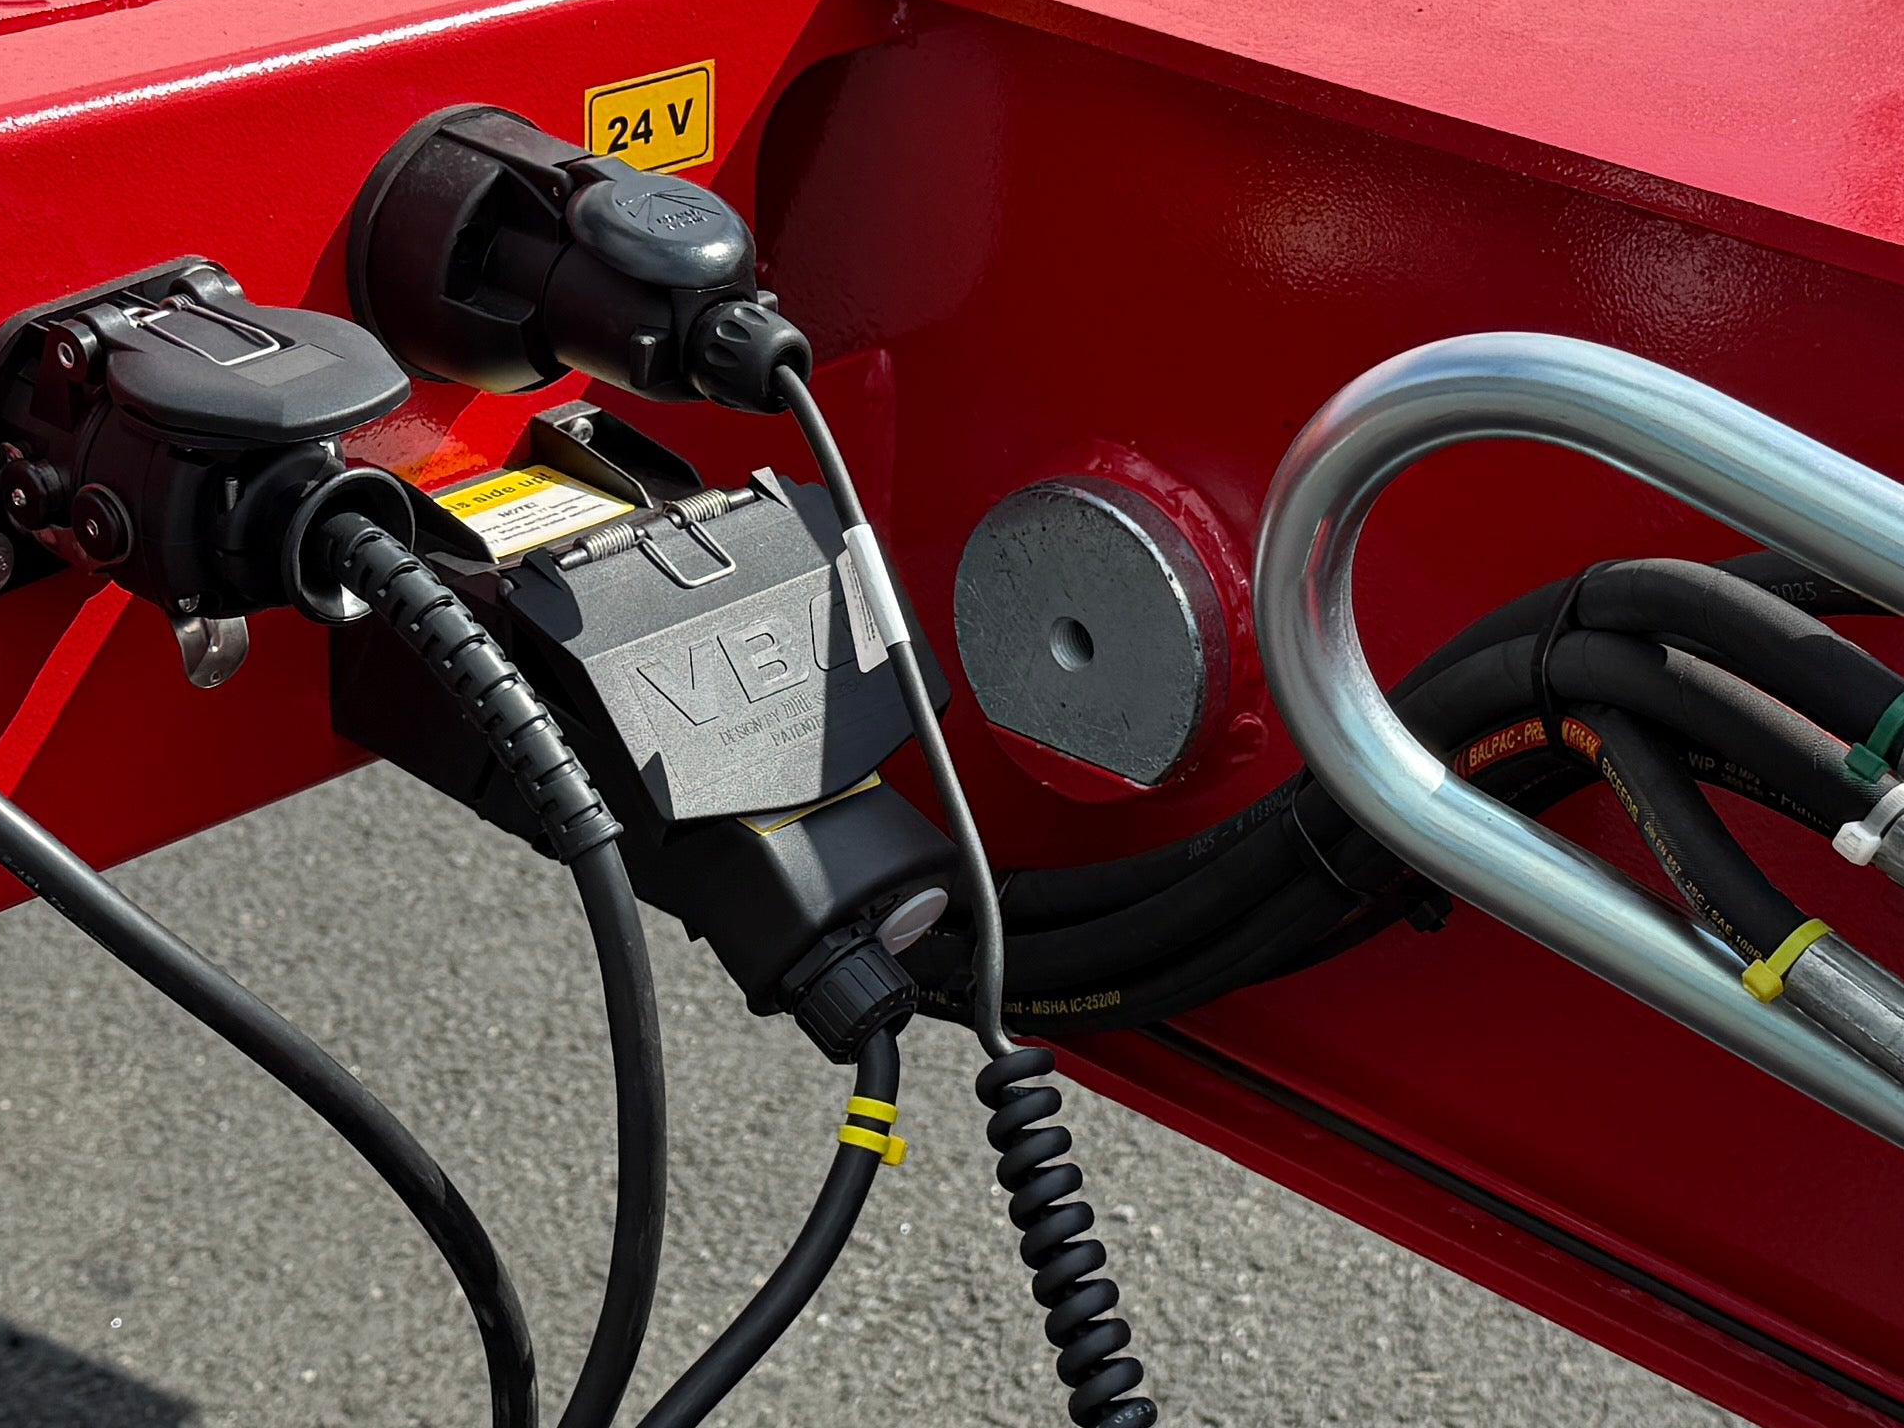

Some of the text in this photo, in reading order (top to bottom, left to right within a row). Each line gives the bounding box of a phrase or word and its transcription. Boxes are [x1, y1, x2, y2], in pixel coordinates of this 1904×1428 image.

[606, 97, 695, 154] 24 V
[1469, 730, 1515, 767] BALPAC
[1688, 751, 1716, 771] WP
[1031, 989, 1121, 1018] MSHA IC-252/00
